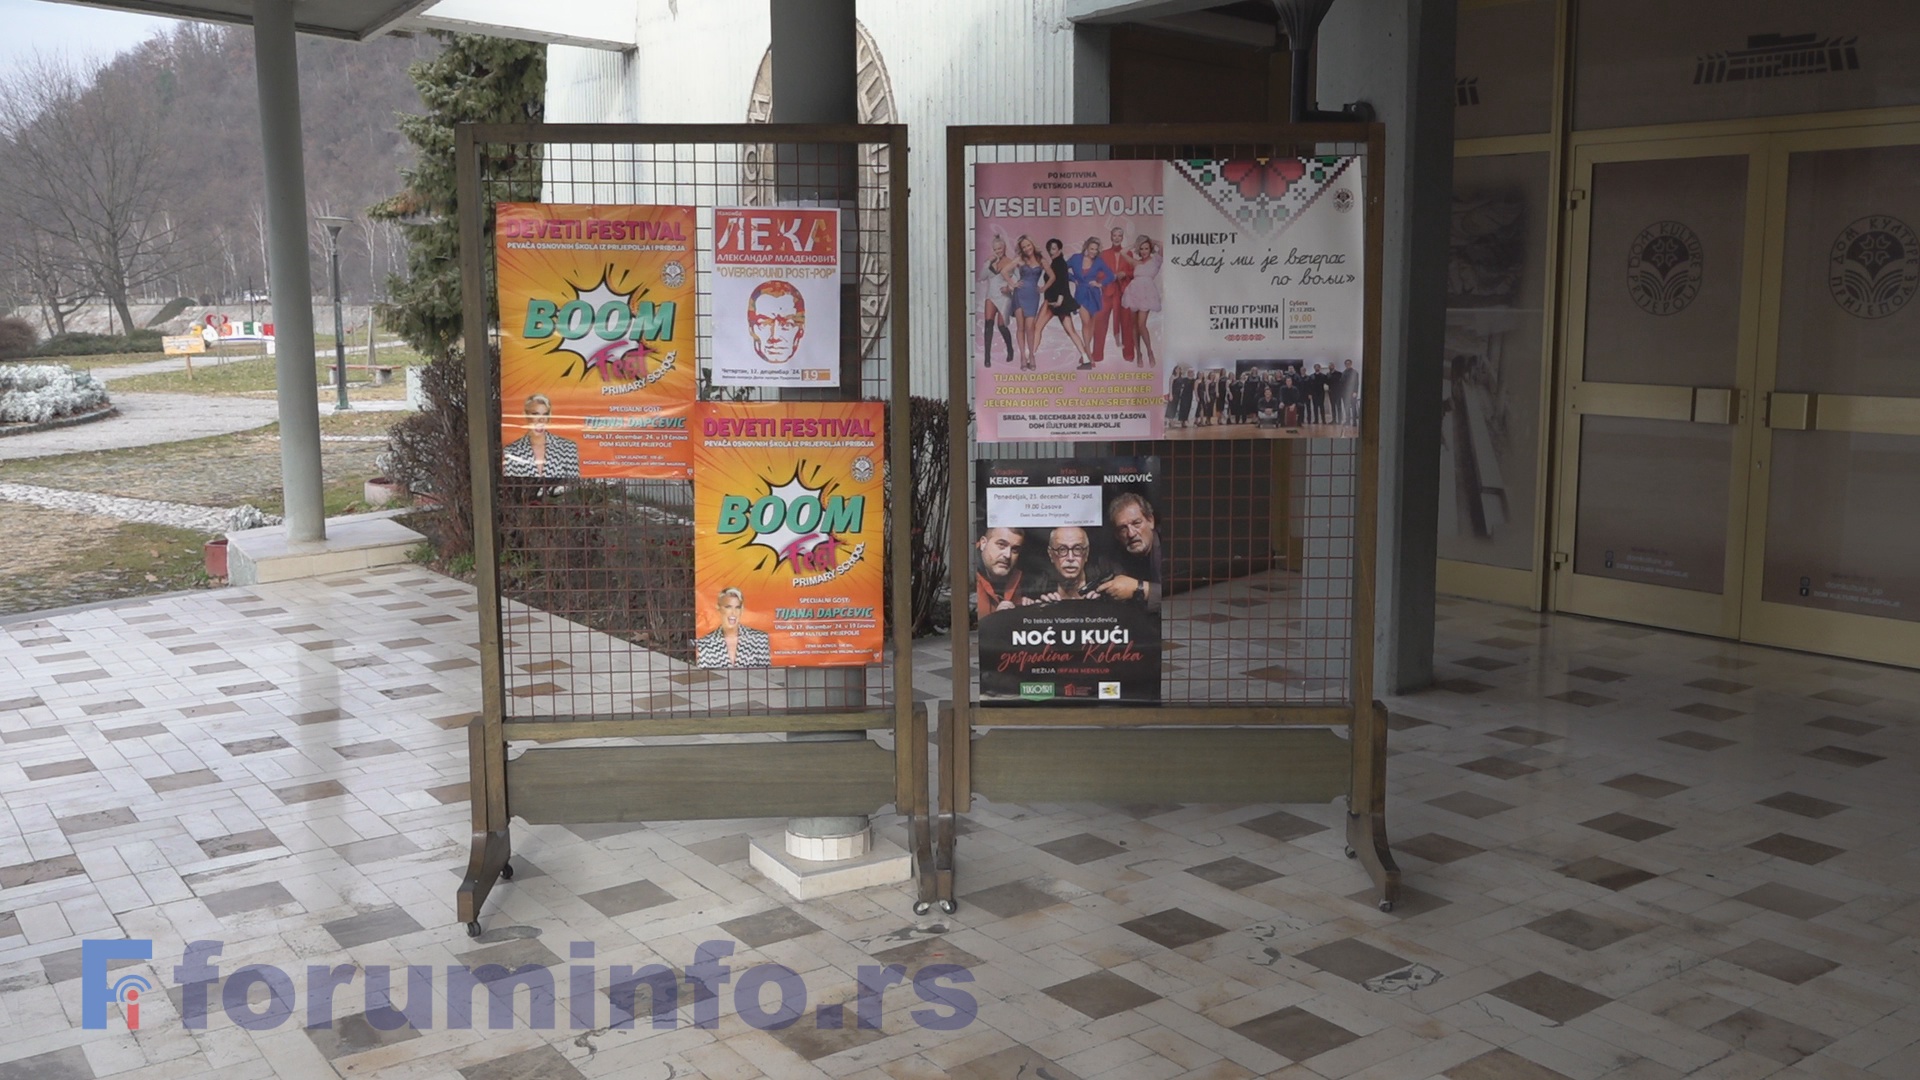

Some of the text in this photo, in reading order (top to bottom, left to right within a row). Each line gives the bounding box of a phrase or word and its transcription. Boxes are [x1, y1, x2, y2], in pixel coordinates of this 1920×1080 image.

[978, 195, 1163, 217] VESELE DEVOJKE
[506, 219, 686, 241] DEVETI FESTIVAL
[717, 217, 832, 252] ЛЕКА
[506, 240, 535, 249] PEVAČA
[1171, 232, 1238, 246] КОНЦЕРТ
[717, 253, 836, 264] АЛЕКСАНДАР МЛАДЕНОВИЋ
[1230, 255, 1255, 266] ми
[1261, 248, 1278, 272] је
[1284, 248, 1346, 271] вечерас
[716, 267, 836, 279] "OVERGROUND POST-POP"
[1271, 274, 1292, 285] по
[1209, 304, 1279, 314] ЕТНО ГРУПА
[523, 299, 676, 341] BOOM
[1210, 317, 1279, 330] ЗЛАТНИК
[1289, 314, 1312, 322] 19.00
[586, 341, 658, 381] Fest
[601, 351, 677, 395] PRIMARY SCHOOL
[804, 371, 818, 380] 19
[1088, 372, 1154, 381] IVANA PETERS
[996, 386, 1034, 394] ZORANA
[984, 399, 1018, 407] JELENA
[1055, 398, 1105, 407] SVETLANA
[585, 417, 624, 429] TIJANA
[703, 418, 876, 438] DEVETI FESTIVAL
[704, 439, 731, 447] PEVAČA
[769, 439, 792, 447] ŠKOLA
[989, 476, 1029, 485] KERKEZ
[1047, 476, 1090, 484] MENSUR
[1103, 472, 1153, 483] NINKOVIĆ
[717, 495, 865, 534] BOOM
[778, 533, 847, 574] Fest
[792, 541, 865, 587] PRIMARY SCHOOL
[775, 608, 814, 620] TIJANA
[1012, 625, 1130, 646] NOĆ U KUĆI
[998, 640, 1144, 672] gospodina Kolaka
